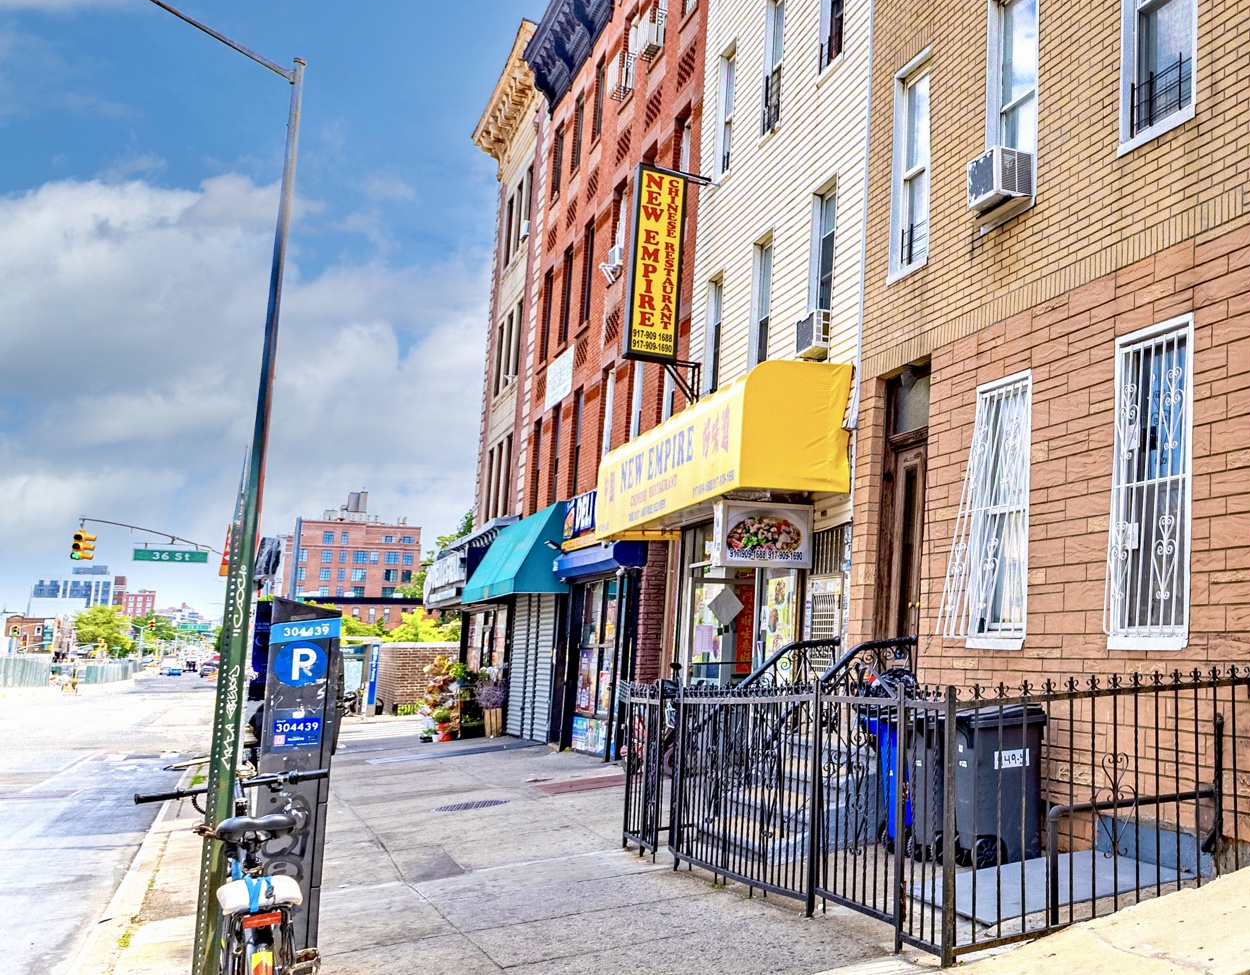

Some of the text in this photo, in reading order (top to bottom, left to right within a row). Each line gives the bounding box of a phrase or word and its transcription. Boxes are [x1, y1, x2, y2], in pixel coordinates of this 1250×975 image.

[638, 173, 665, 328] NEW EMPIRE
[661, 179, 680, 330] CHINESE RESTAURANT
[658, 332, 673, 343] 1688
[620, 451, 644, 494] NEW
[647, 425, 695, 481] EMPIRE
[574, 491, 594, 532] DELI
[152, 551, 191, 561] 36 St
[283, 626, 330, 637] 304439
[276, 722, 319, 733] 304439
